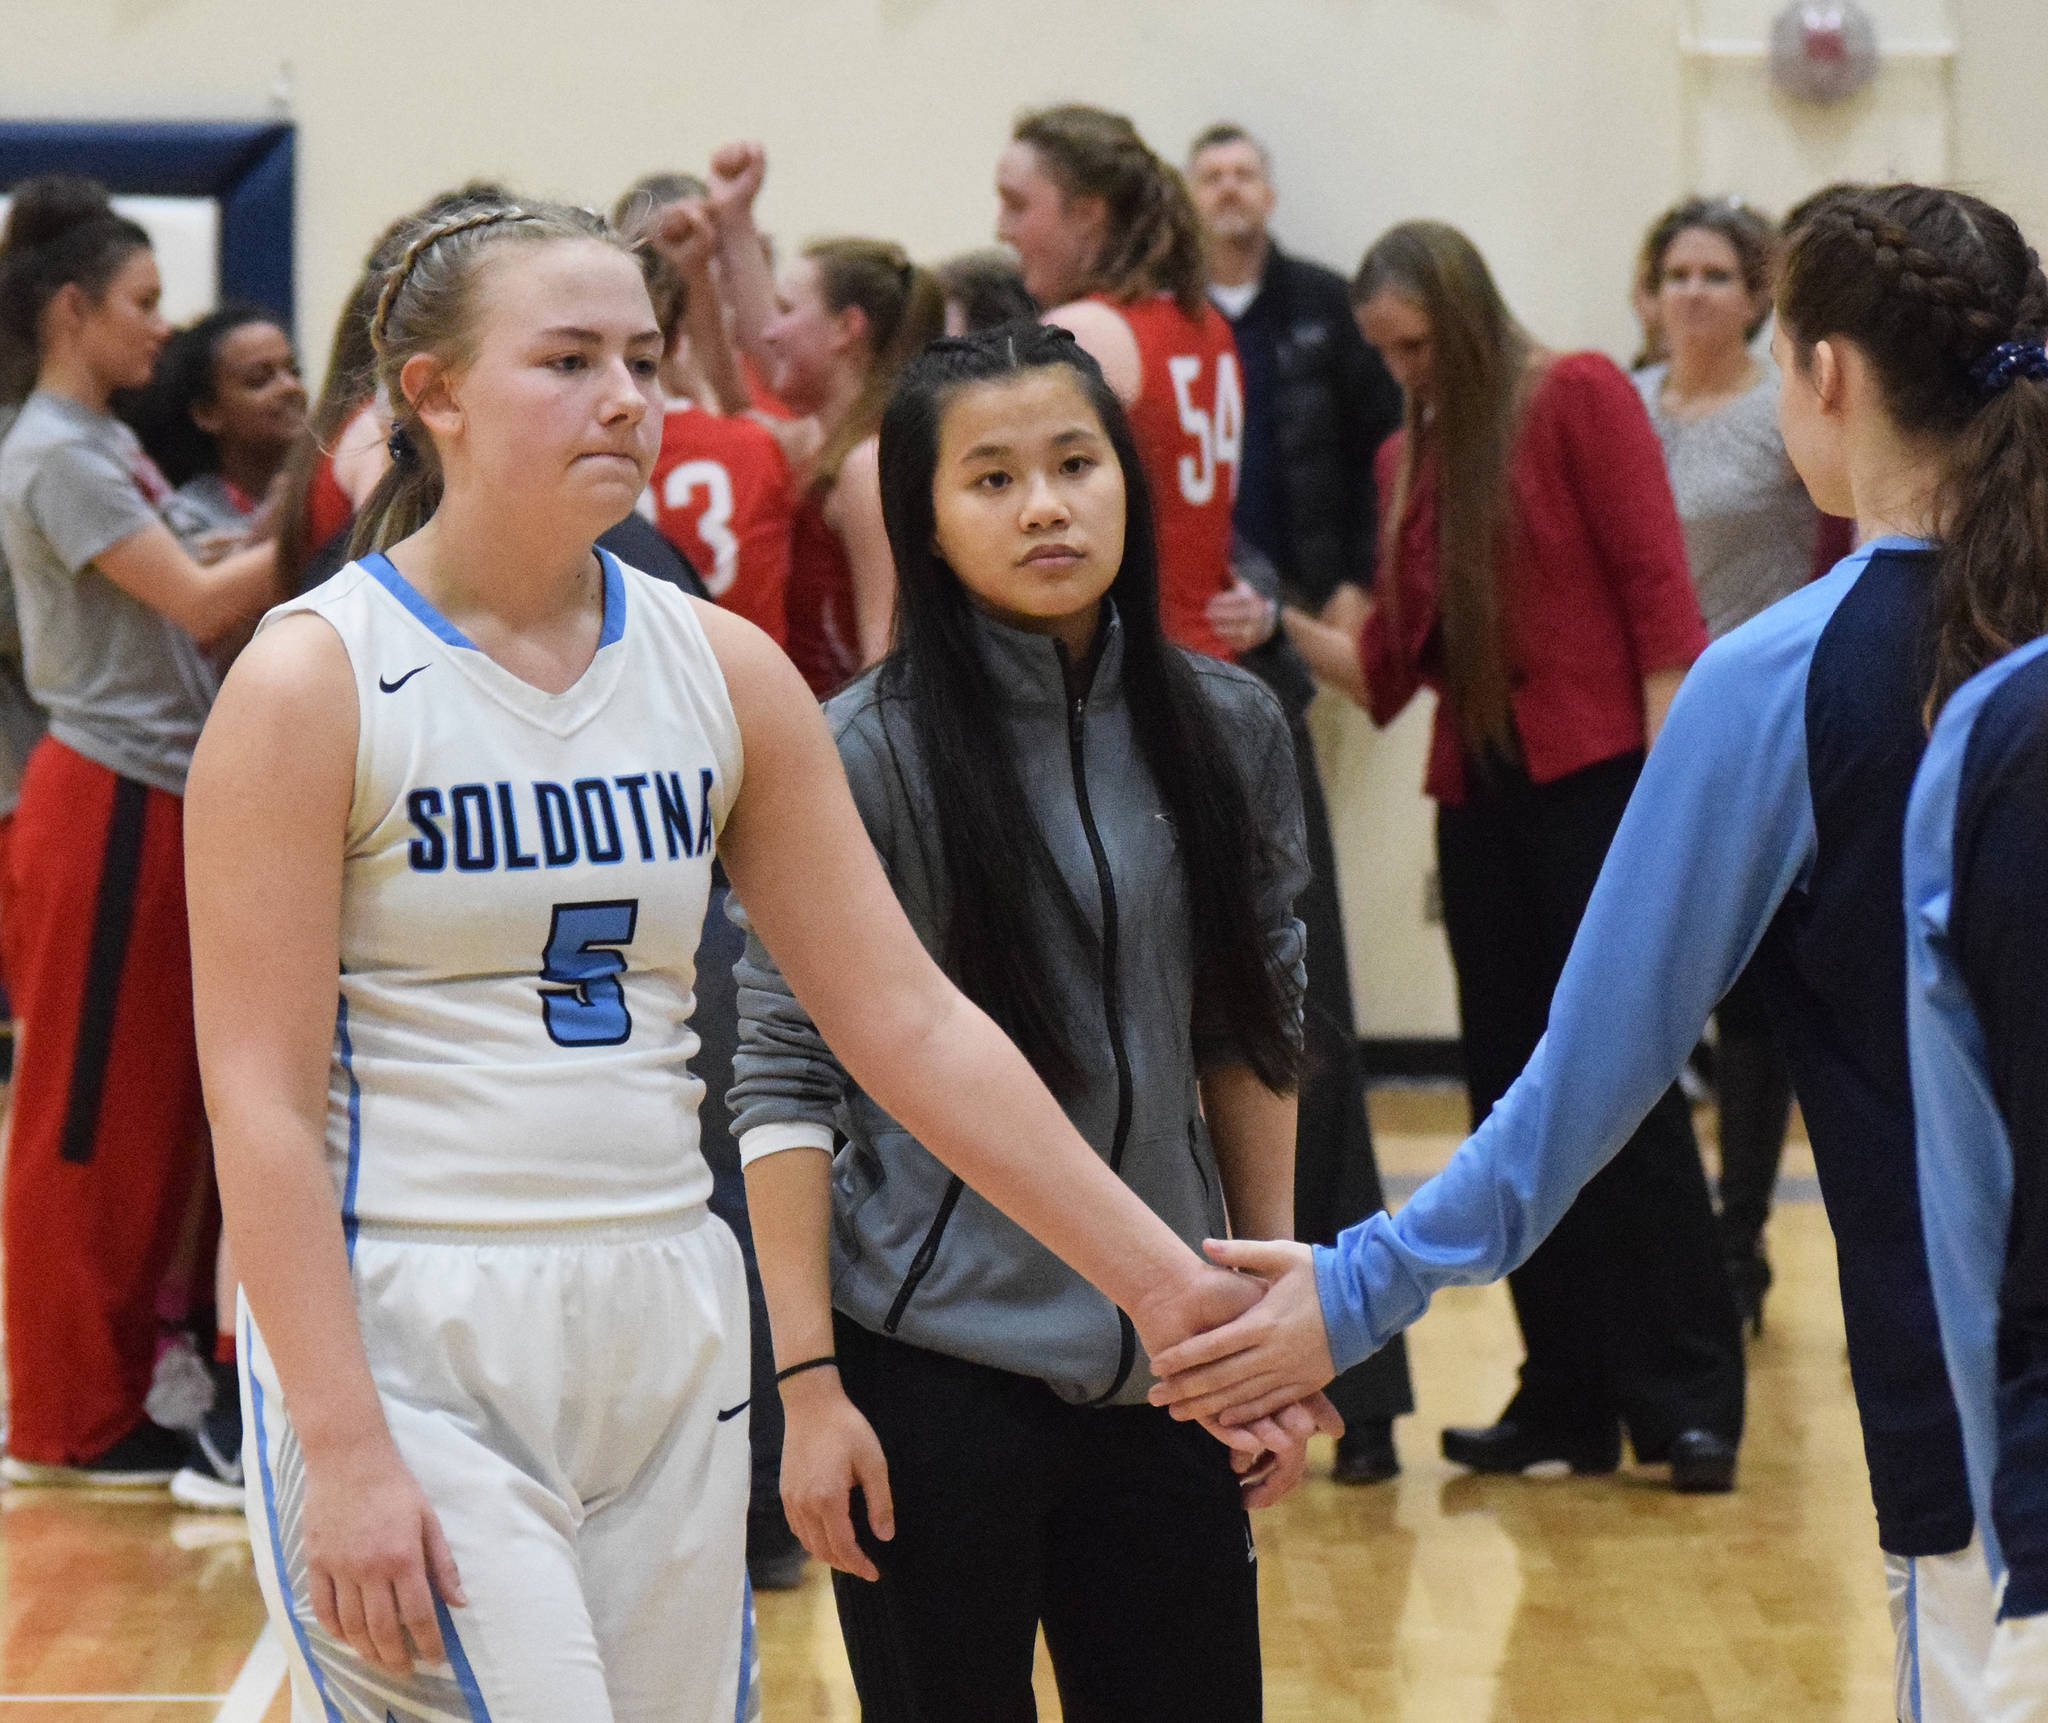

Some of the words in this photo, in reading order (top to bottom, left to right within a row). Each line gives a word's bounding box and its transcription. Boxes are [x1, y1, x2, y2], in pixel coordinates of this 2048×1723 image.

[1168, 353, 1244, 506] 54
[634, 459, 739, 598] 3
[406, 767, 714, 873] SOLDOTNA
[537, 898, 639, 1048] 5
